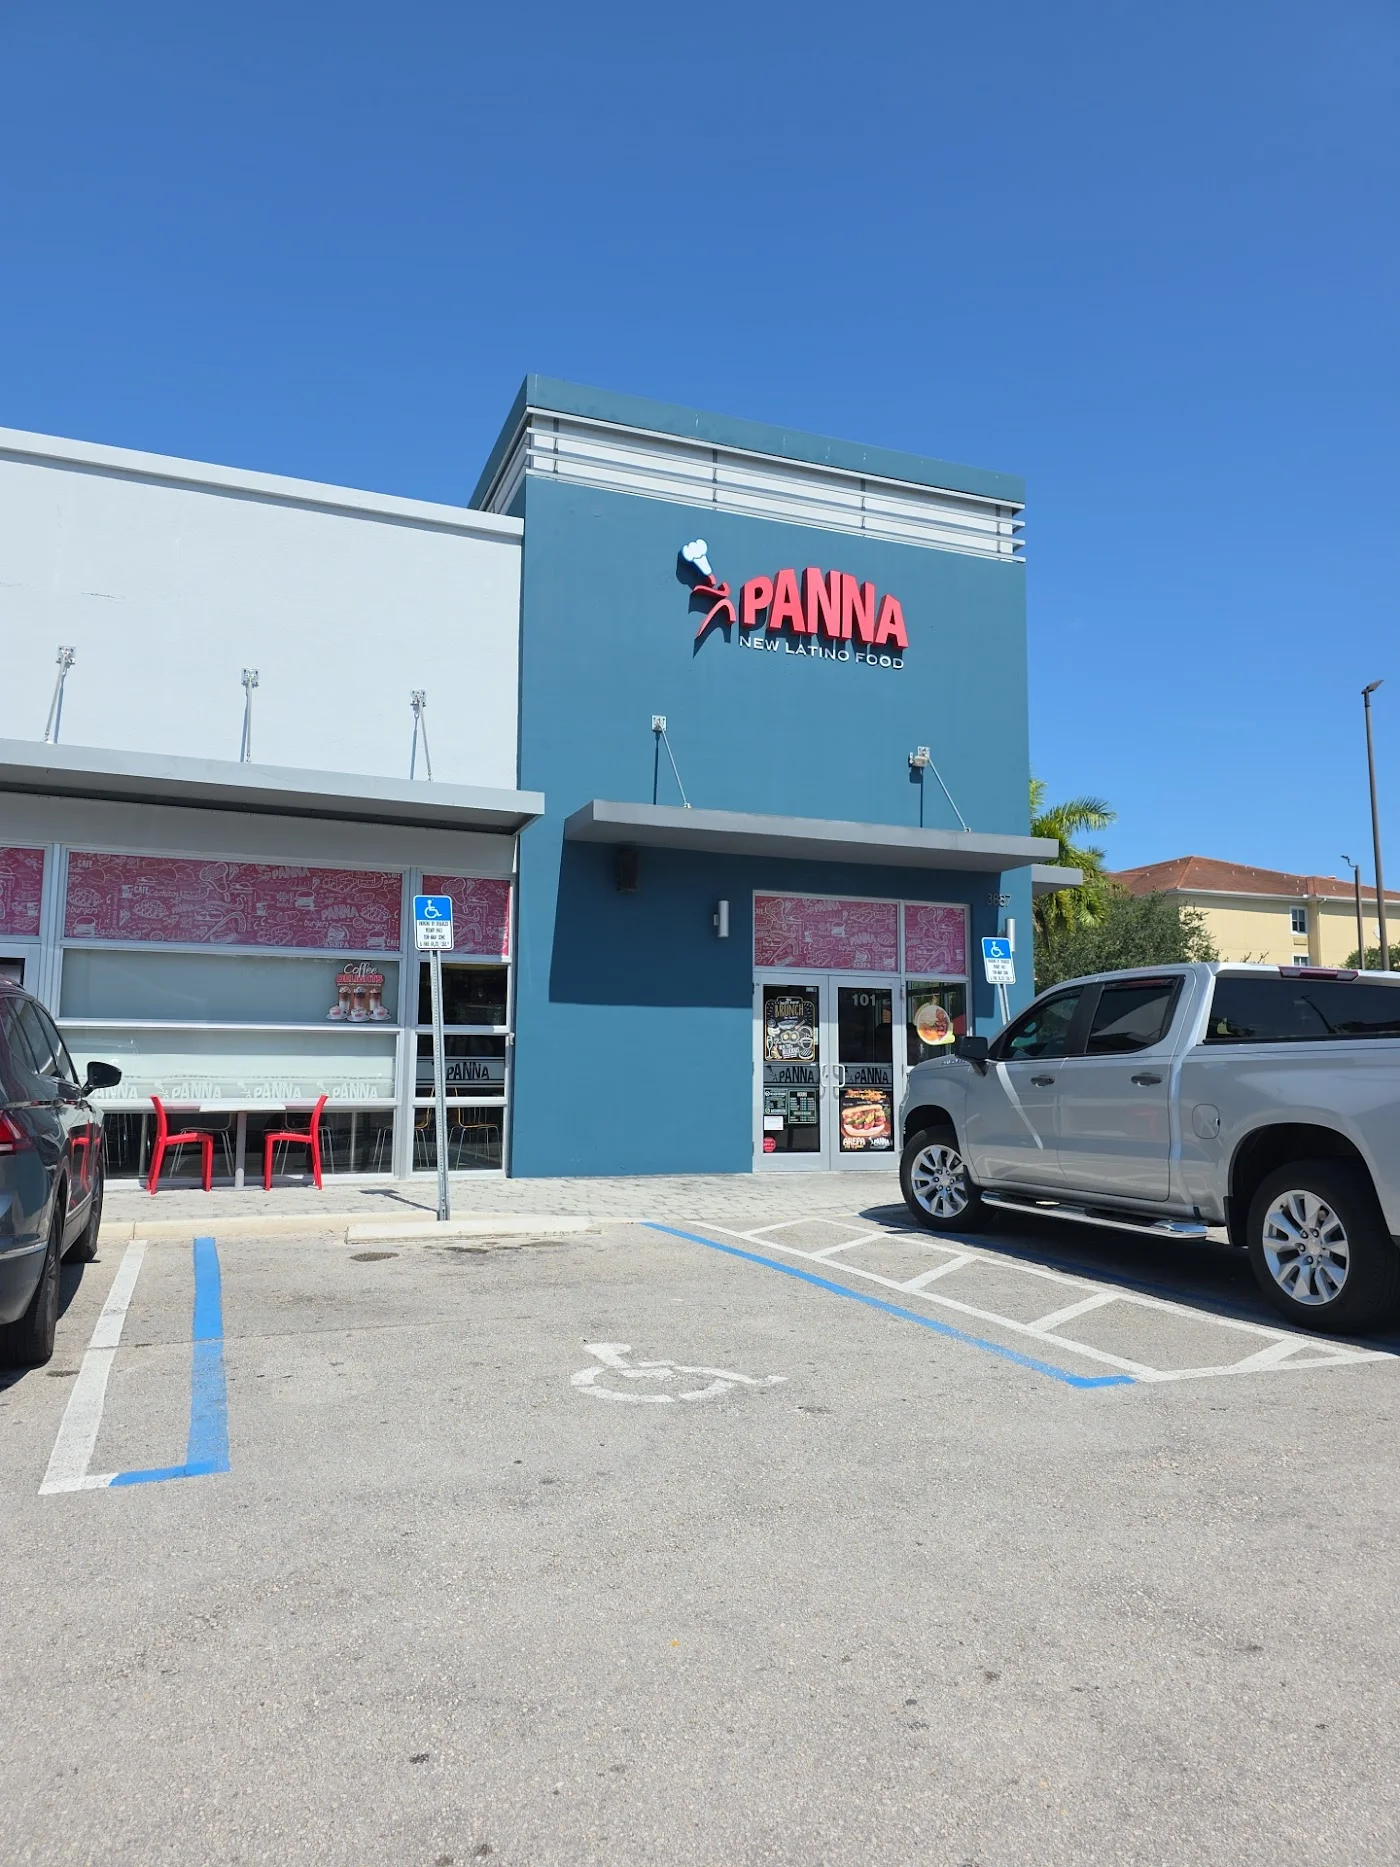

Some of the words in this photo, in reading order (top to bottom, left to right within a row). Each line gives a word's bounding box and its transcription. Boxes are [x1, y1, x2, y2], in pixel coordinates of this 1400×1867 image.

[740, 566, 909, 650] PANNA
[739, 636, 779, 652] NEW
[785, 642, 849, 662] LATINO
[855, 652, 904, 670] FOOD
[321, 905, 358, 920] PANNA
[336, 973, 384, 983] DELIGHTS
[343, 962, 377, 977] Coffee
[852, 993, 876, 1006] 101
[775, 1004, 804, 1017] BRUNCH
[446, 1062, 490, 1080] PANNA
[779, 1066, 815, 1083] PANNA
[854, 1067, 889, 1084] PANNA
[92, 1083, 138, 1099] ANNA
[171, 1081, 222, 1098] PANNA
[253, 1081, 302, 1098] PANNA
[331, 1081, 378, 1098] PANNA
